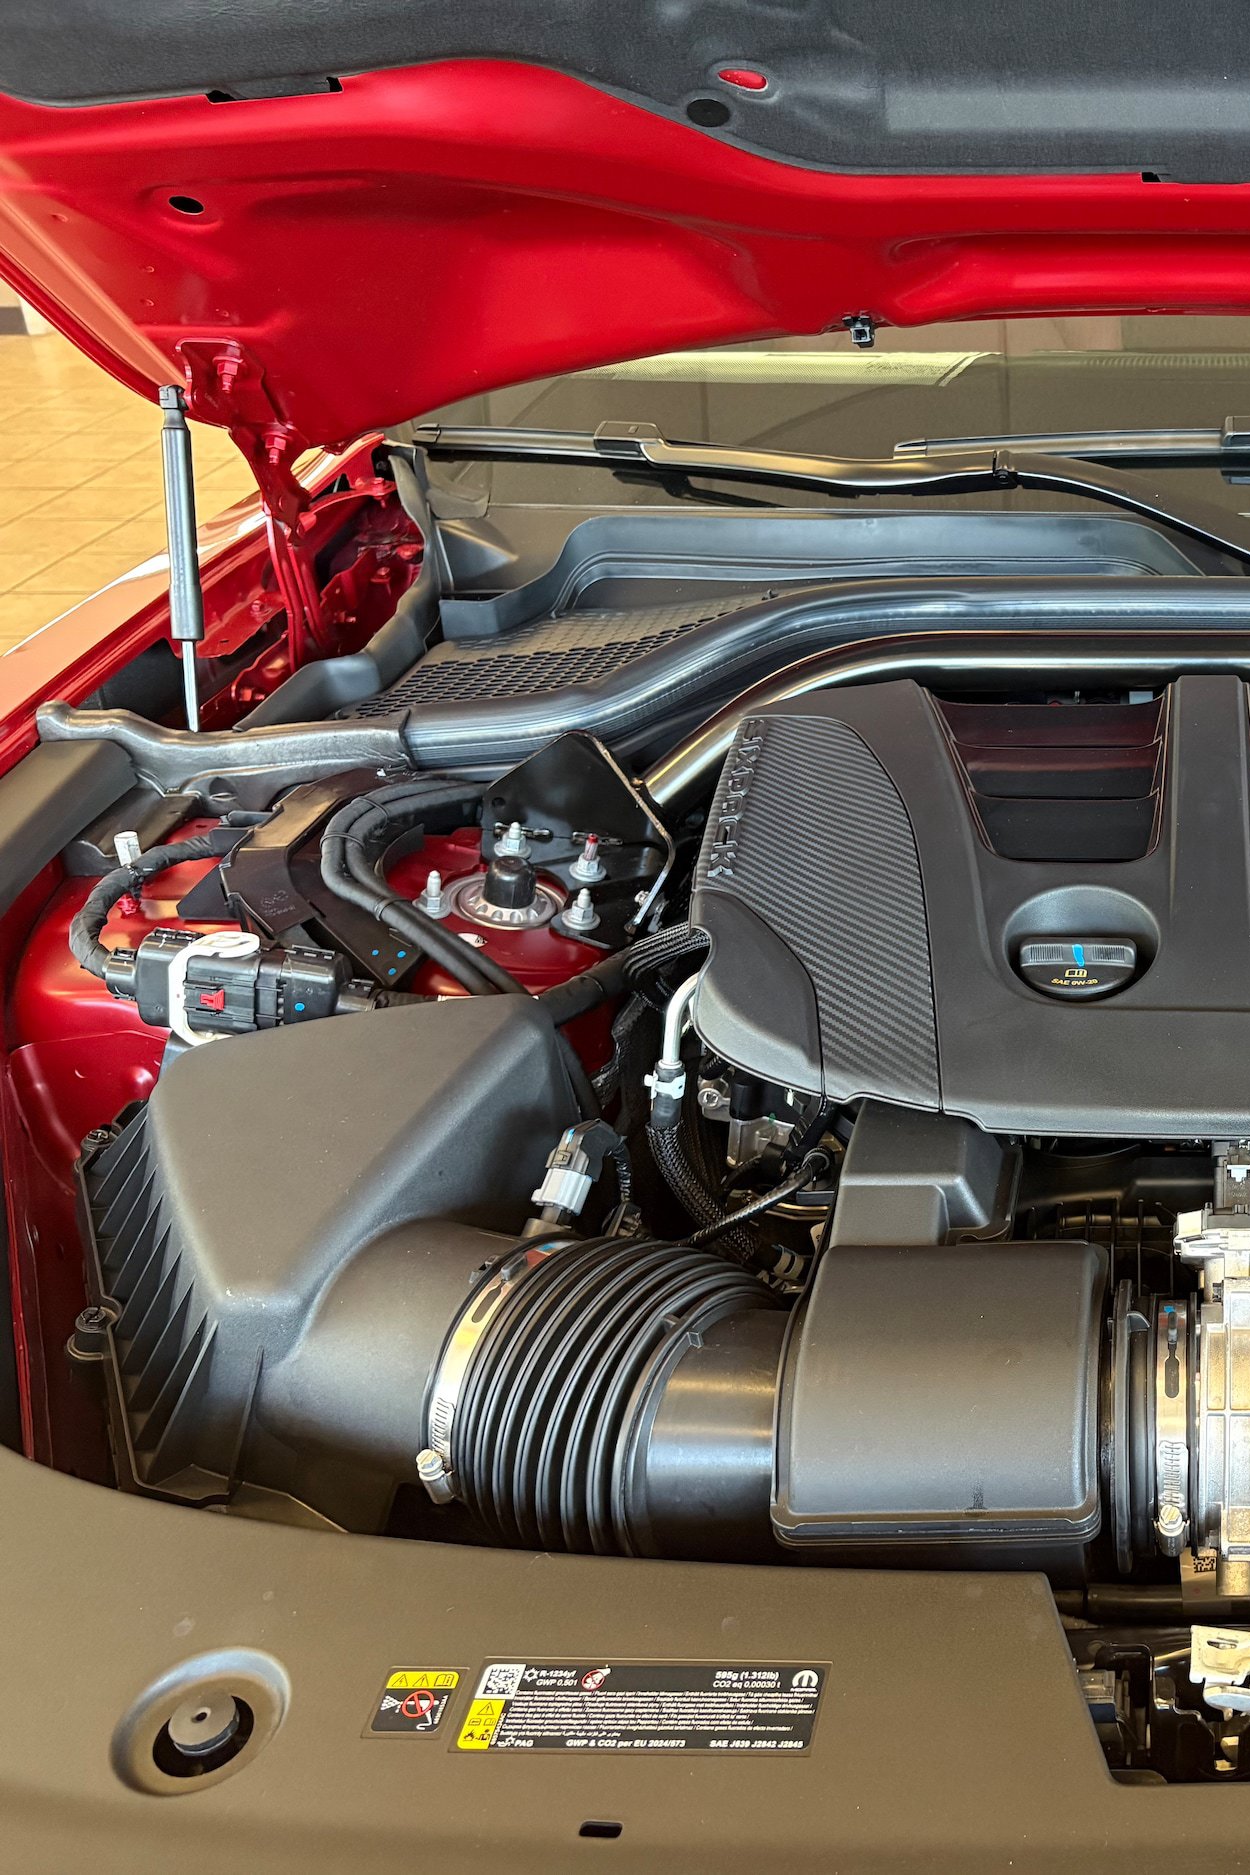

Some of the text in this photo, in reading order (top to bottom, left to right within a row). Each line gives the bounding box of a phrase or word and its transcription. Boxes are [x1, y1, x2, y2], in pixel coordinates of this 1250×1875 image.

[707, 719, 768, 878] SIXPACK
[1050, 977, 1071, 986] SAE
[539, 1669, 577, 1678] R-1234yf
[536, 1678, 556, 1686] GWP
[732, 1682, 743, 1690] eq
[513, 1739, 534, 1747] PAG
[565, 1739, 588, 1747] GWP
[588, 1739, 596, 1747] &
[596, 1739, 616, 1747] CO2
[632, 1740, 647, 1748] EU
[709, 1740, 729, 1748] SAE
